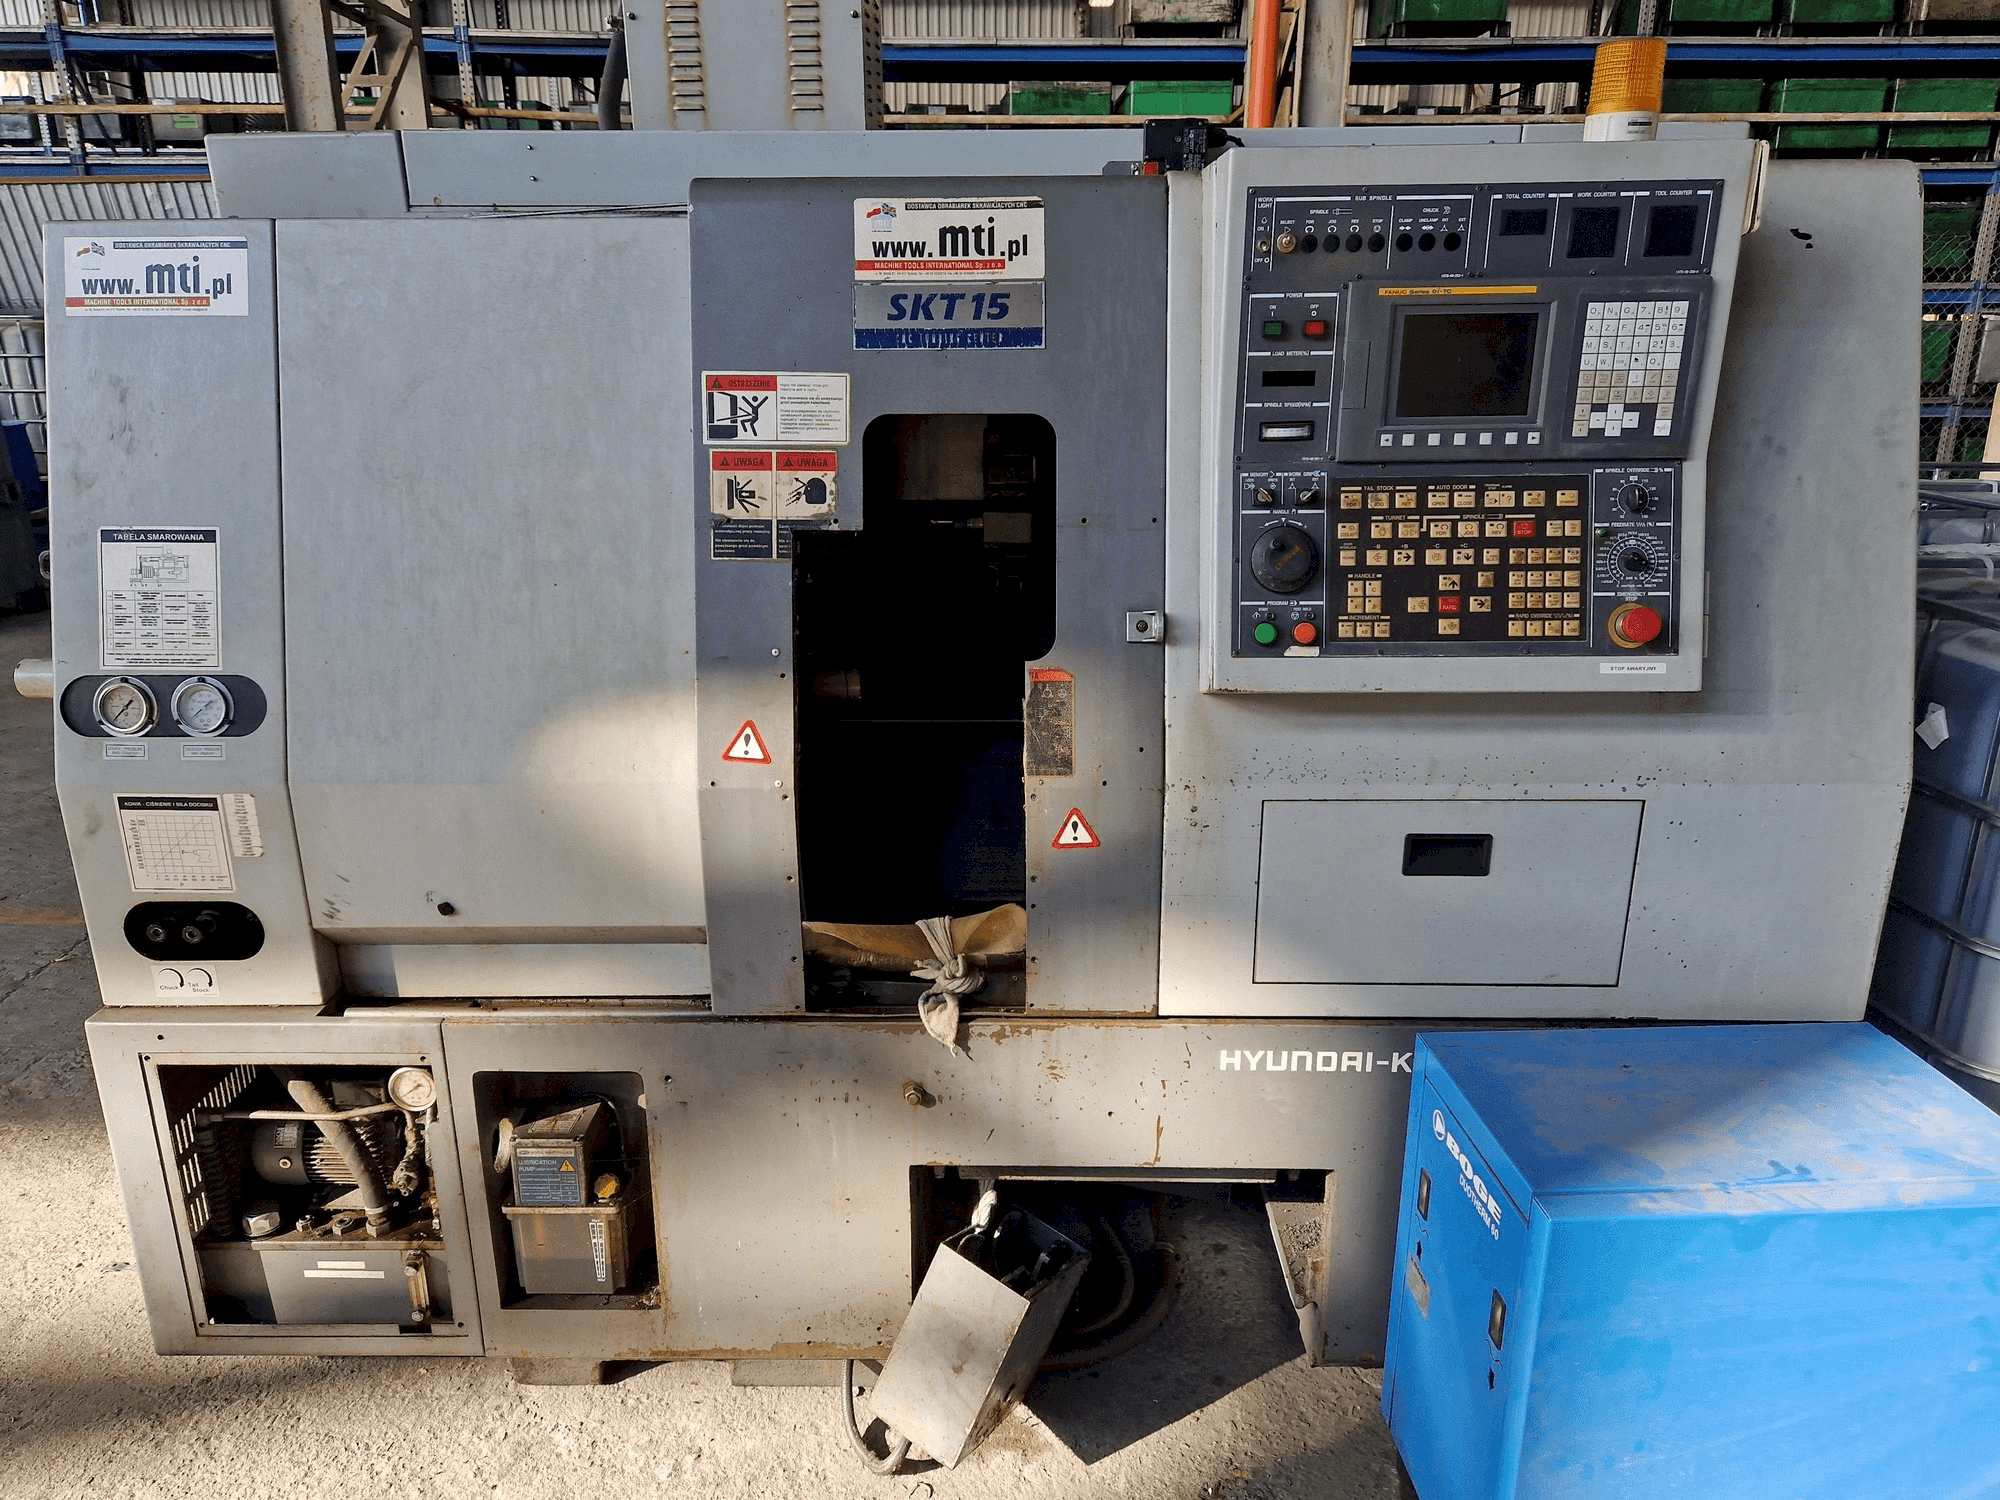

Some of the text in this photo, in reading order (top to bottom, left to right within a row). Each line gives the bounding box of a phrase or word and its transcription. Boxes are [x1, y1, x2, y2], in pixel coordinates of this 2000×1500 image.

[872, 216, 1028, 261] www.mti.pl
[81, 255, 232, 299] www.mti.pl
[84, 298, 113, 306] MACHINE
[887, 293, 1011, 321] SKT 15
[733, 458, 765, 466] UWAGA
[797, 458, 828, 467] UWAGA
[113, 533, 205, 541] TABELA SMAROWANIA
[1219, 1050, 1413, 1073] HYUNDAI-K
[1446, 1131, 1501, 1225] BOGE
[1460, 1173, 1491, 1228] DUOTHERM
